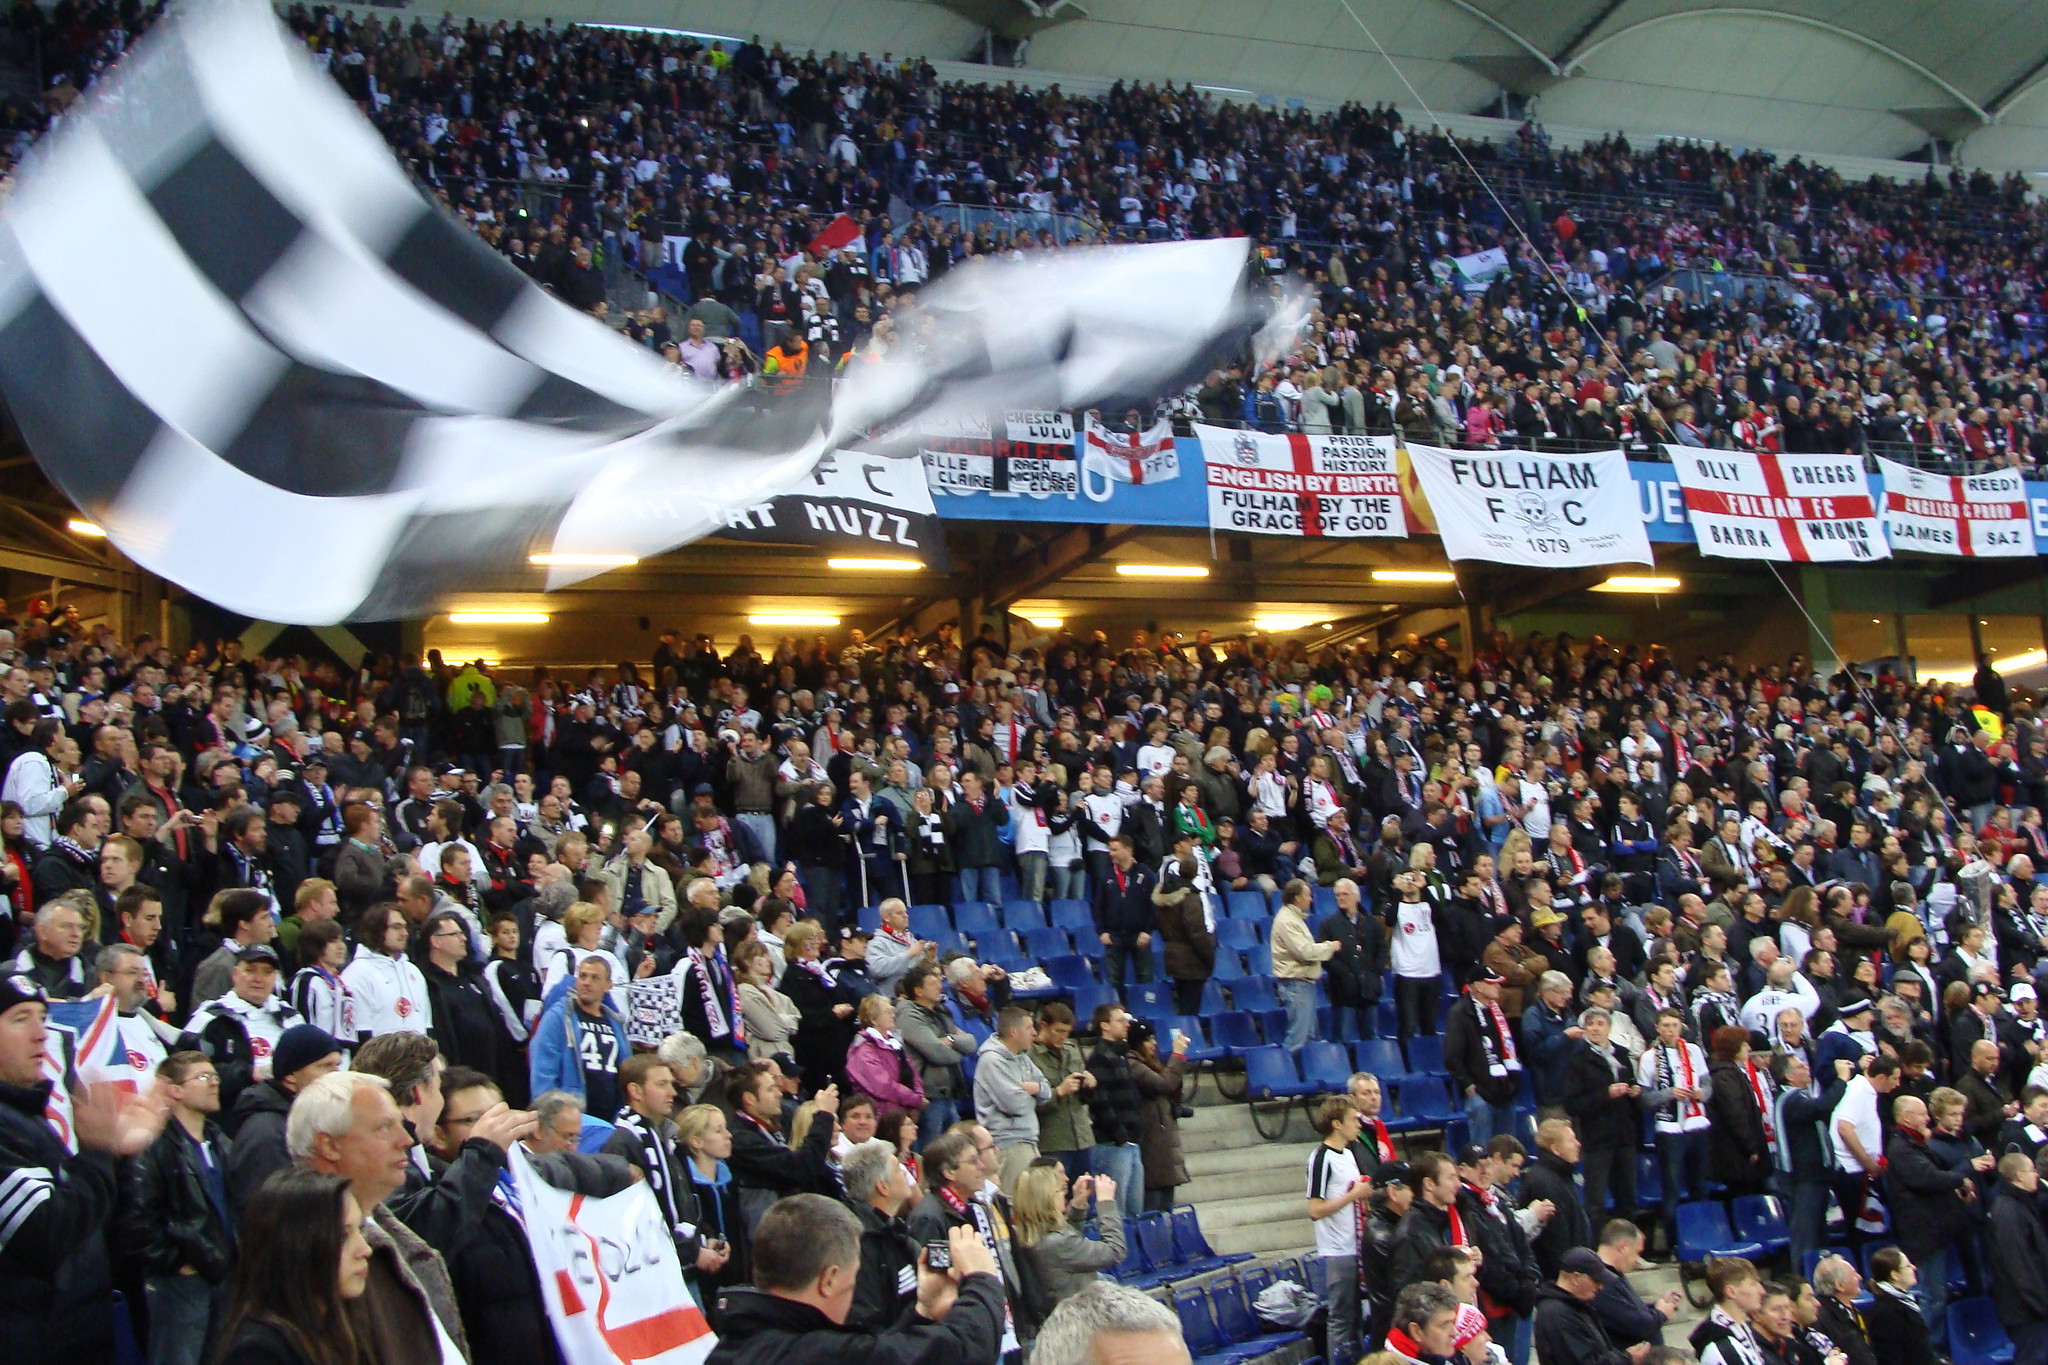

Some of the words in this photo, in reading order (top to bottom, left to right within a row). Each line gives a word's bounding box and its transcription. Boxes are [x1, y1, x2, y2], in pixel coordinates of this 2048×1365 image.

[1030, 426, 1072, 440] LULU
[1329, 436, 1375, 446] PRIDE
[930, 438, 1029, 457] FULHAM
[1035, 443, 1067, 461] FC
[1322, 447, 1387, 459] PASSION
[926, 454, 968, 471] ELLE
[1014, 460, 1050, 471] RACH
[1323, 460, 1387, 472] HISTORY
[1696, 459, 1741, 482] OLLY
[938, 471, 993, 489] CLAIRE
[1208, 465, 1304, 491] ENGLISH
[1305, 475, 1334, 492] BY
[1337, 475, 1399, 493] BIRTH
[1450, 459, 1599, 489] FULHAM
[1791, 464, 1857, 484] CHEGGS
[1968, 478, 2020, 492] REEDY
[1222, 491, 1312, 513] FULHAM
[1320, 498, 1347, 513] BY
[1352, 498, 1391, 514] THE
[1486, 497, 1506, 523] F
[1563, 501, 1587, 527] C
[1637, 481, 1687, 523] UE
[1726, 494, 1805, 519] FULHAM
[1811, 499, 1836, 518] FC
[1905, 498, 1960, 519] ENGLISH
[804, 502, 919, 549] MUZZ
[1232, 511, 1308, 530] GRACE
[1314, 516, 1340, 531] OF
[1346, 516, 1388, 531] GOD
[1805, 521, 1869, 540] WRONG
[1526, 537, 1571, 553] 1879
[1894, 525, 1954, 545] JAMES
[1986, 531, 2022, 546] SAZ
[1850, 540, 1872, 557] UN
[580, 1031, 619, 1073] 47
